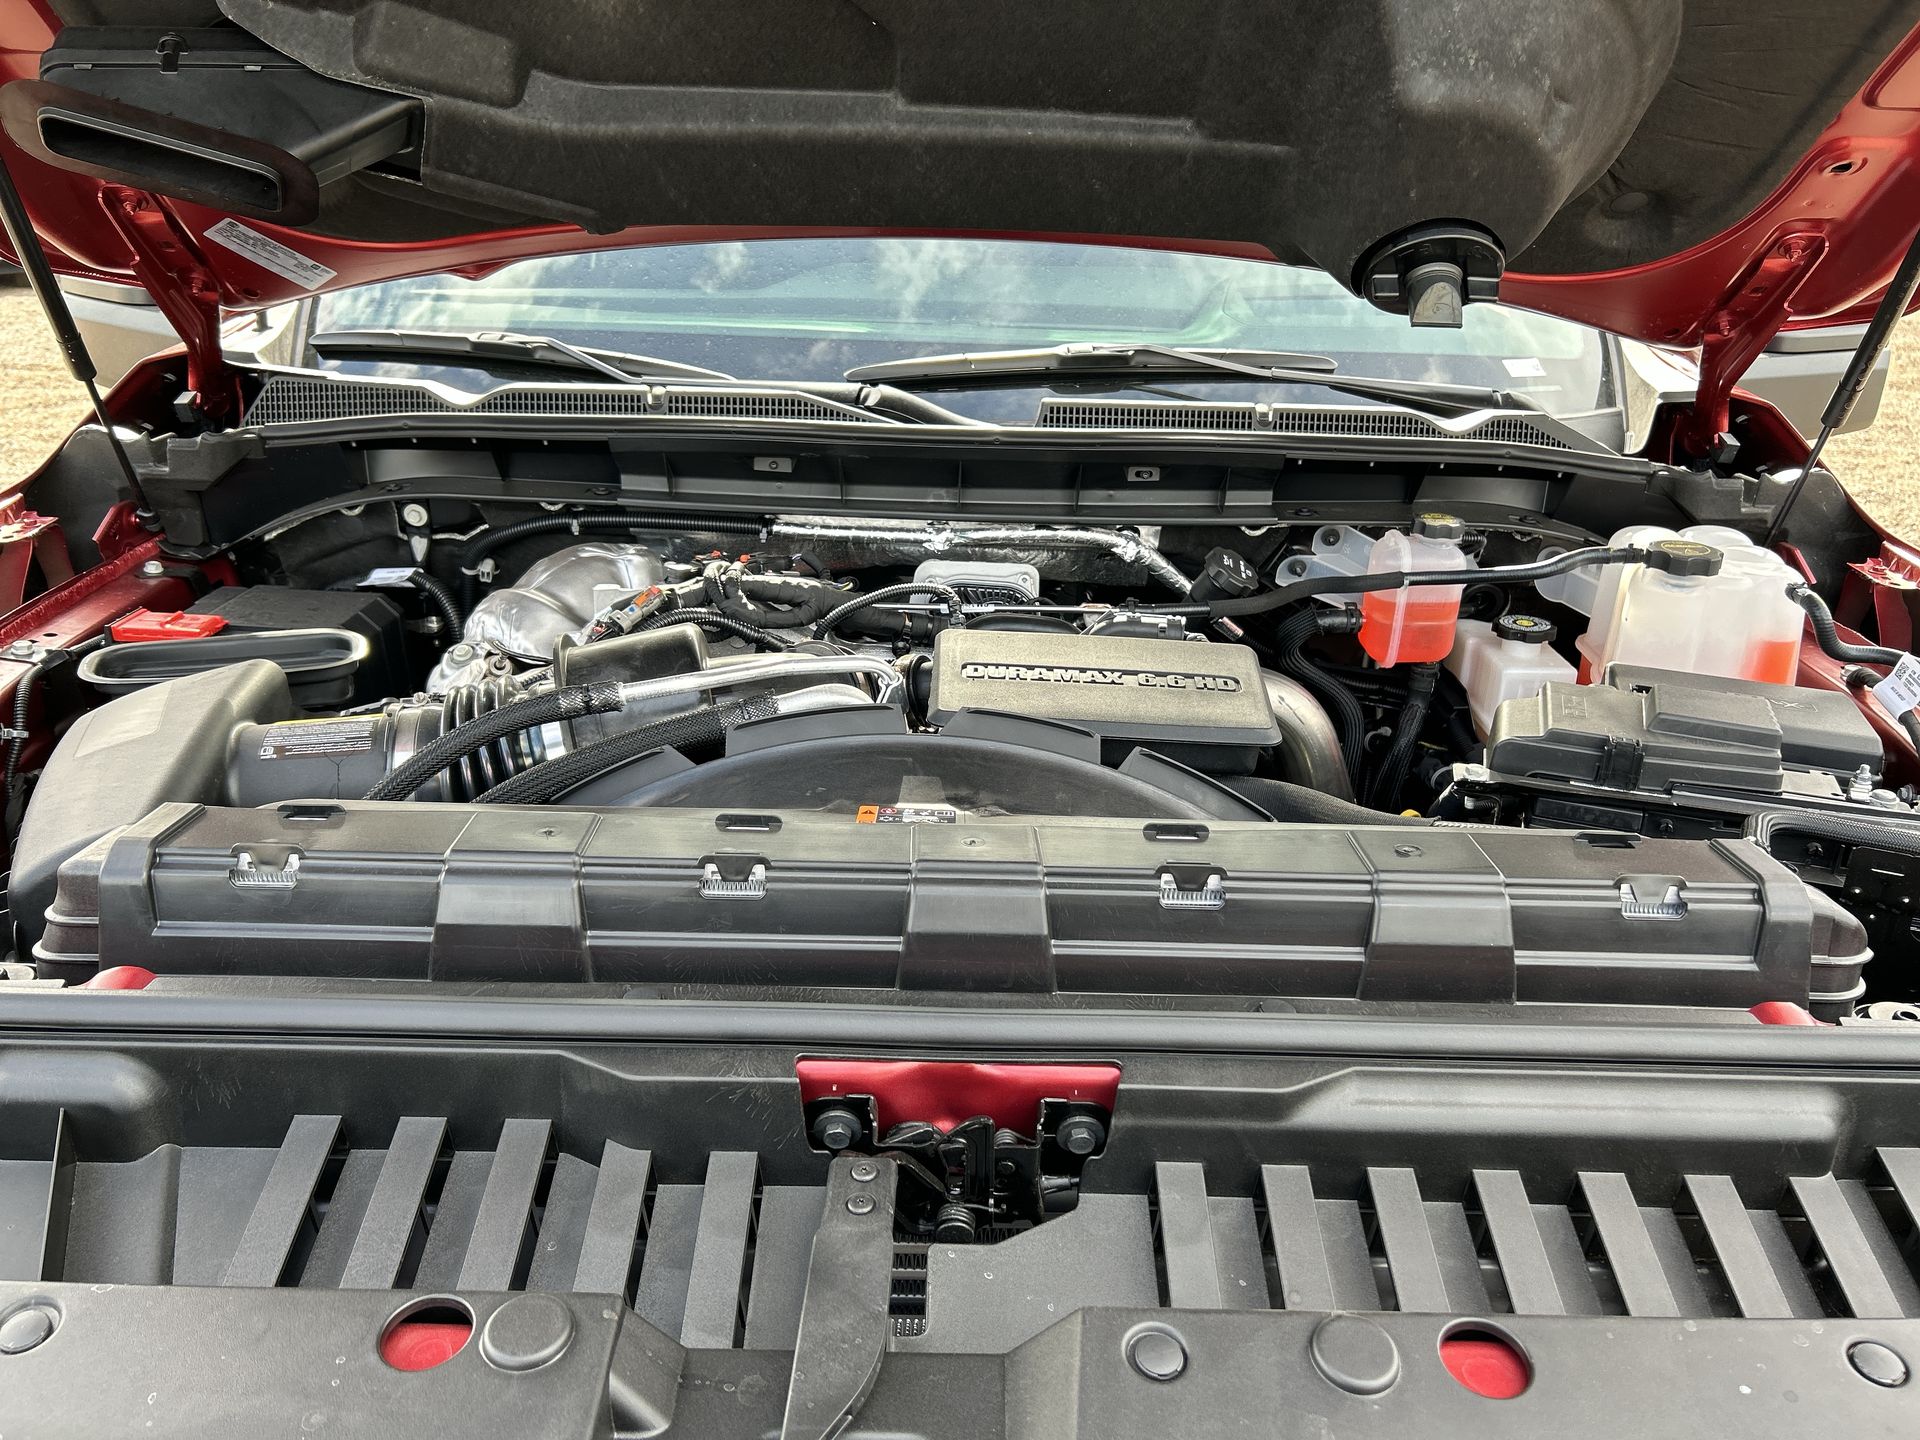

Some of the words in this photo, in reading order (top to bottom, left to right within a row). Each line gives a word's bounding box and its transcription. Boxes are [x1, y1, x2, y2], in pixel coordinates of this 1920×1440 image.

[964, 664, 1124, 685] DURAMAX
[1137, 673, 1186, 688] 6.6
[1194, 676, 1237, 691] HD
